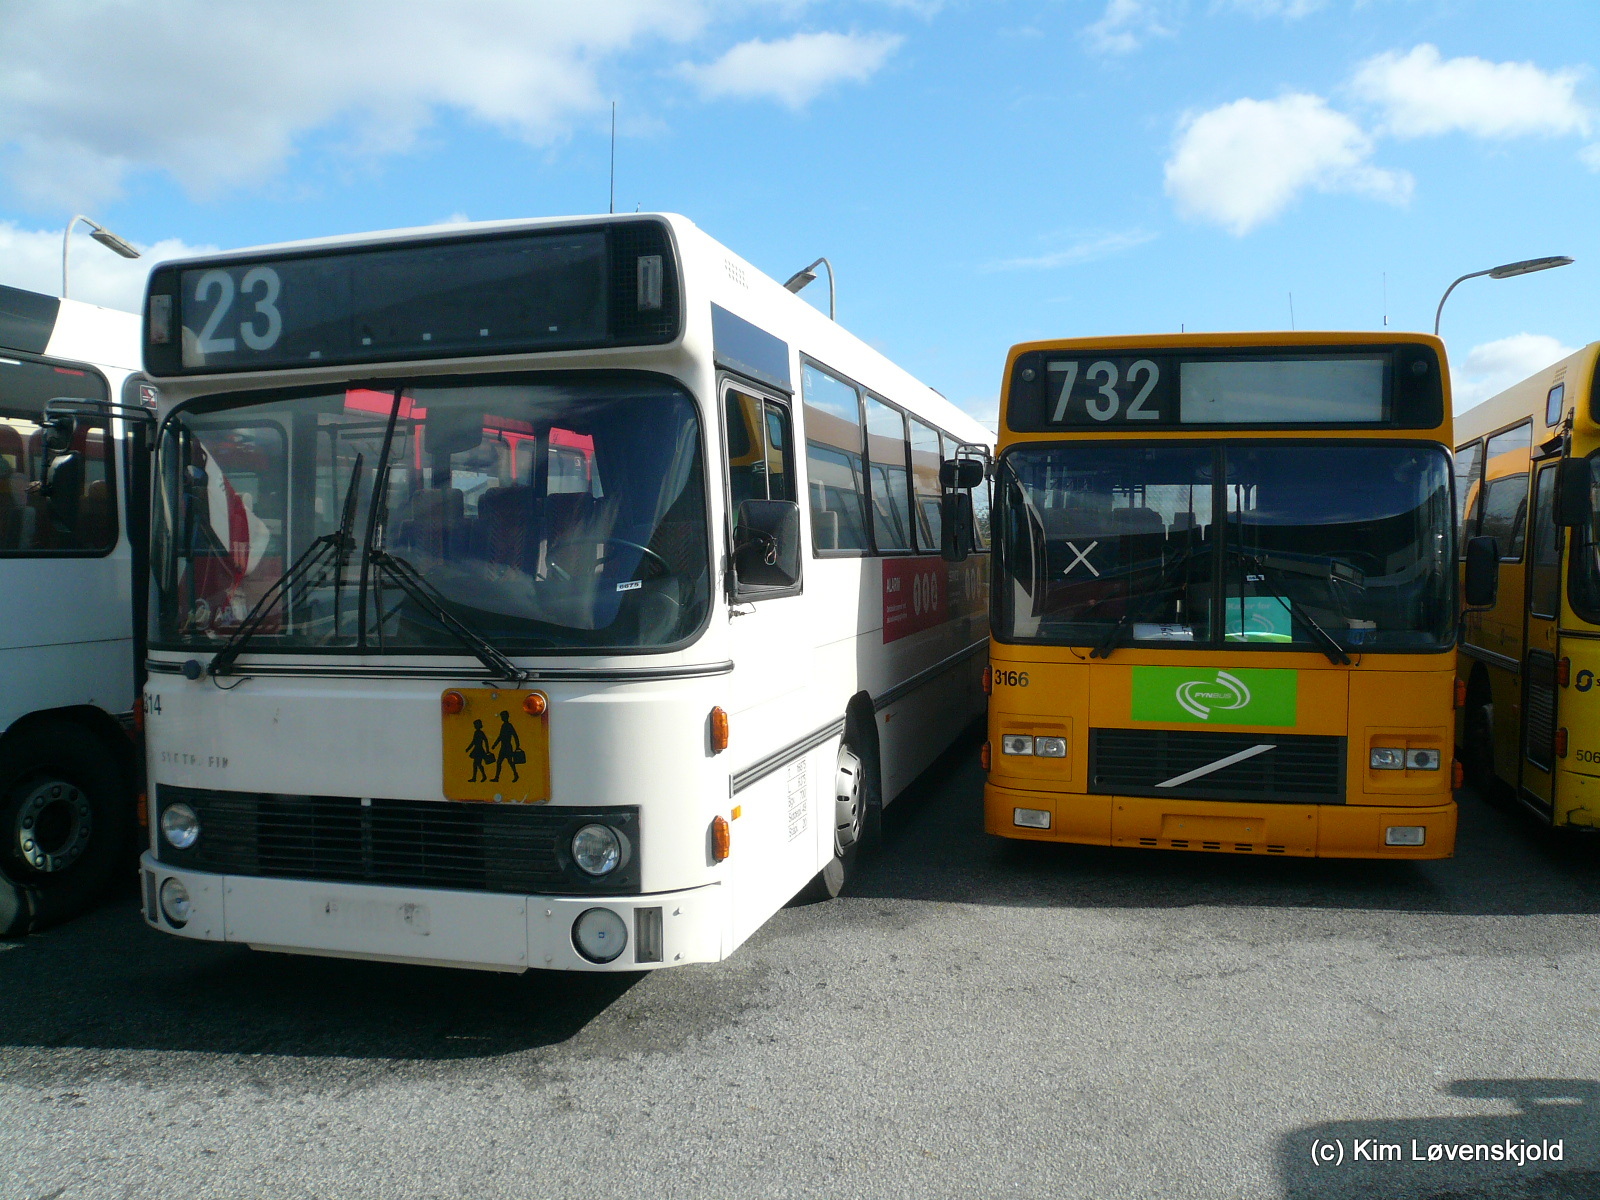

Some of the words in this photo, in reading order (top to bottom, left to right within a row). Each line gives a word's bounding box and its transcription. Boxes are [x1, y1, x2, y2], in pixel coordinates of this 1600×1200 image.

[195, 267, 282, 354] 23
[1047, 360, 1160, 421] 732
[994, 669, 1029, 687] 3166
[1576, 749, 1600, 764] 506
